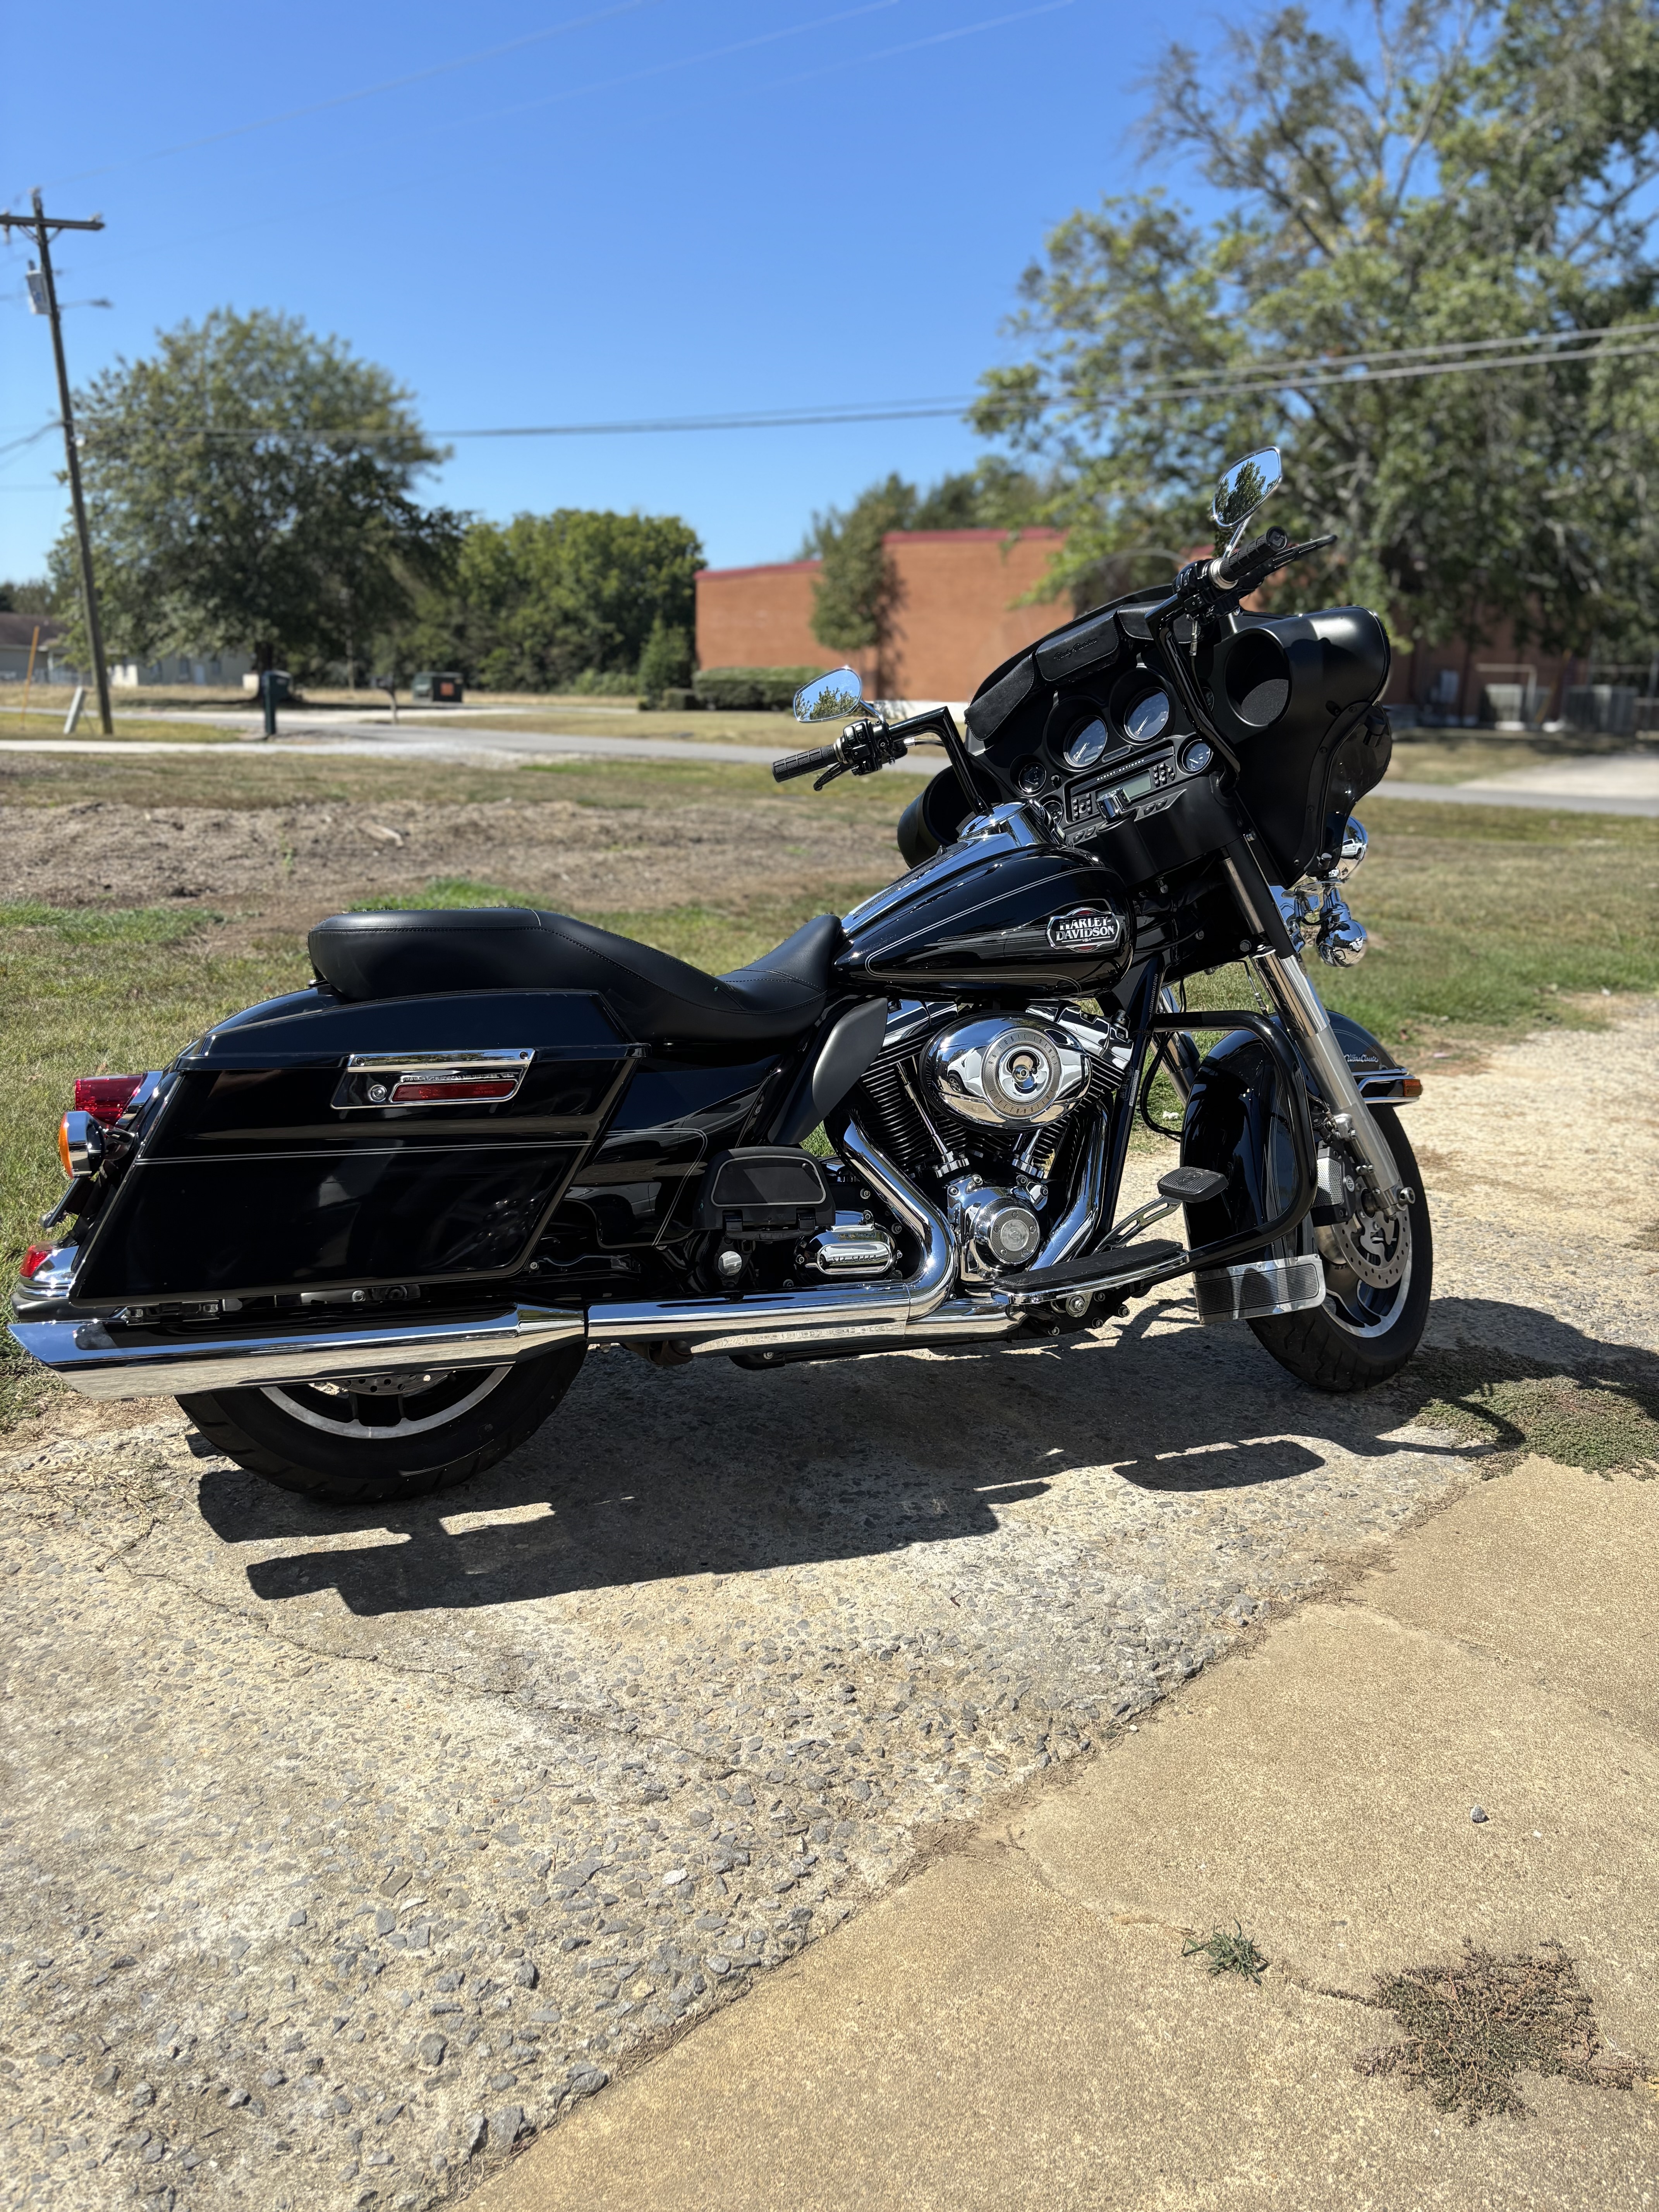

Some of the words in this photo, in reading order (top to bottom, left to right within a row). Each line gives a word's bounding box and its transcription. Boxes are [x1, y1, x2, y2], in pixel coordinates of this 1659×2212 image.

[1059, 916, 1111, 930] HARLEY-
[1056, 926, 1115, 941] DAVIDSON
[998, 1034, 1026, 1049] CUBIC
